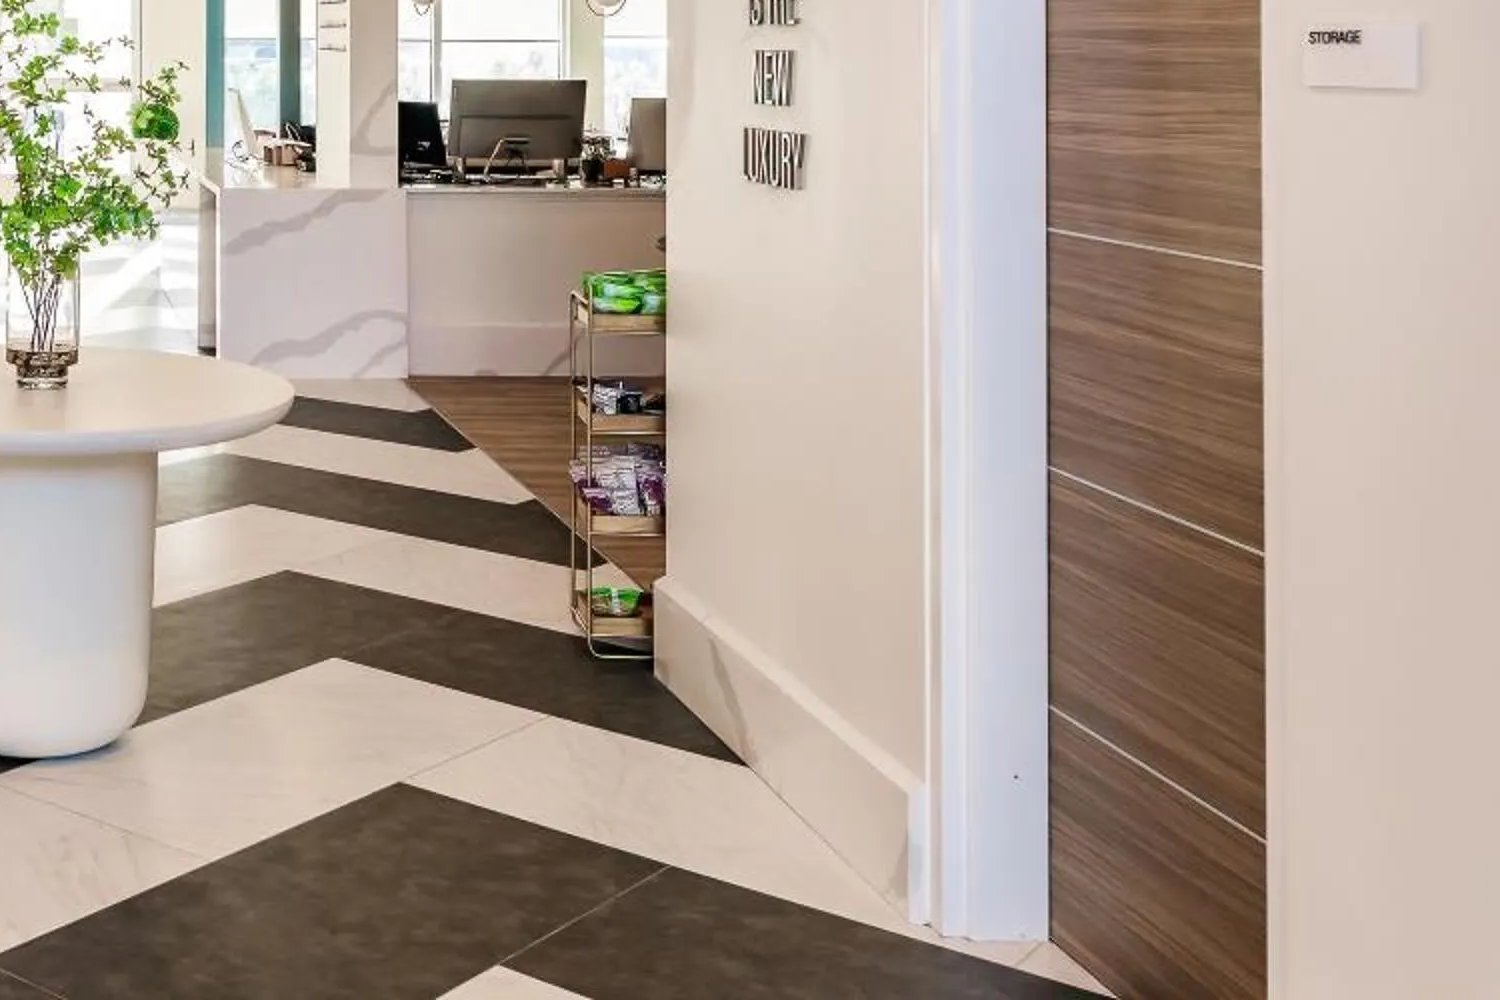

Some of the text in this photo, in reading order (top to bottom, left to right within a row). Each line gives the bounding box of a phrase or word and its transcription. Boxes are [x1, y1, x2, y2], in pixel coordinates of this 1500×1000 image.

[1308, 30, 1362, 45] STORAGE
[752, 49, 793, 106] NEW
[740, 127, 808, 190] LUXURY
